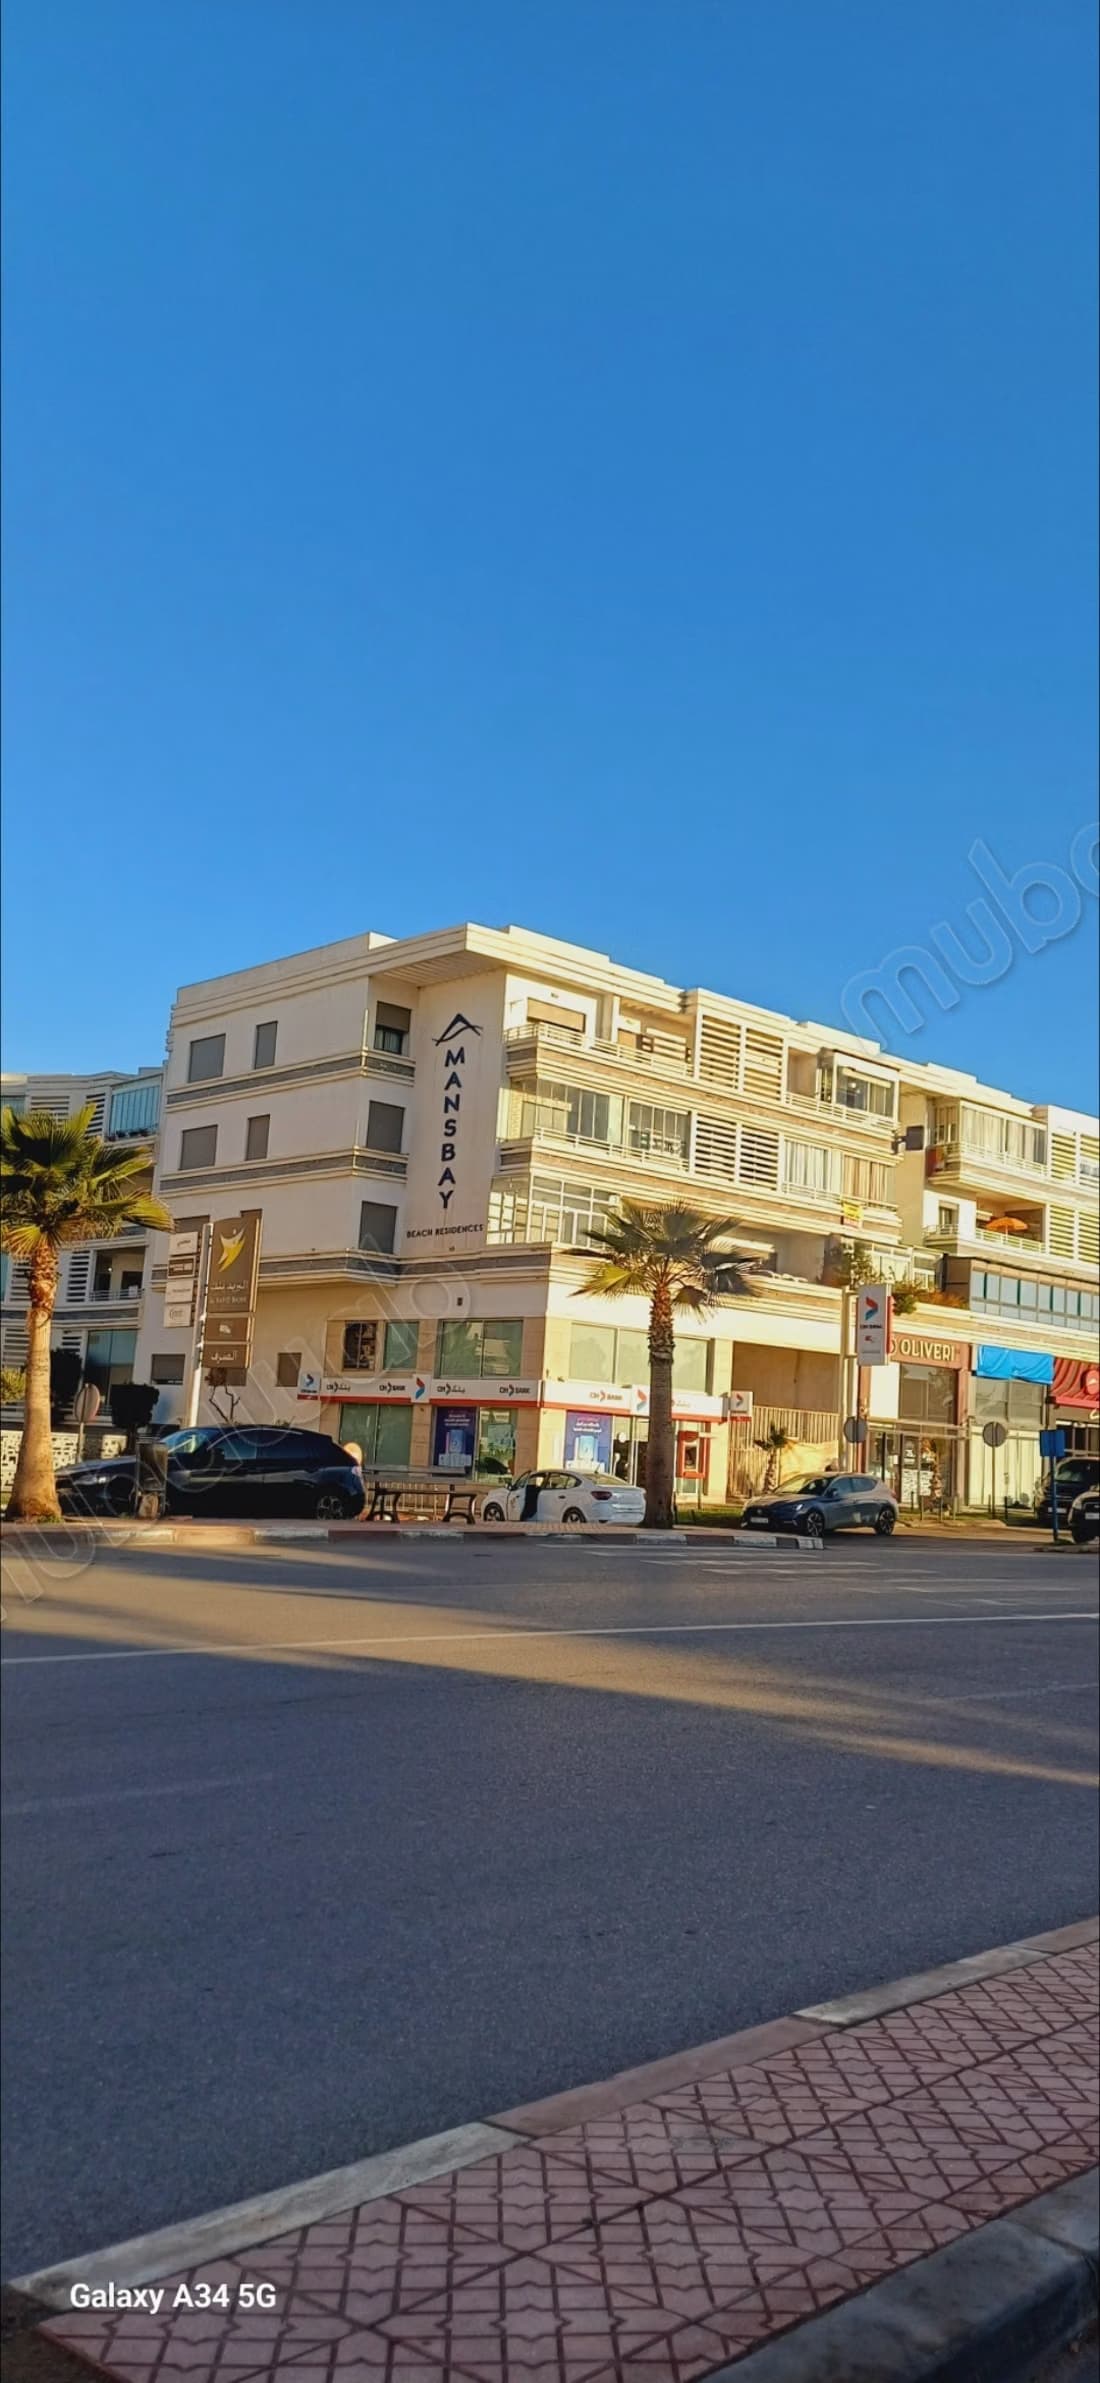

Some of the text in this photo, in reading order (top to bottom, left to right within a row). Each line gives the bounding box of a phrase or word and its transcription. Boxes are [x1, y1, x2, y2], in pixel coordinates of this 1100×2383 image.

[406, 1223, 484, 1239] BEACH RESIDENCES
[900, 1338, 955, 1361] OLIVERI
